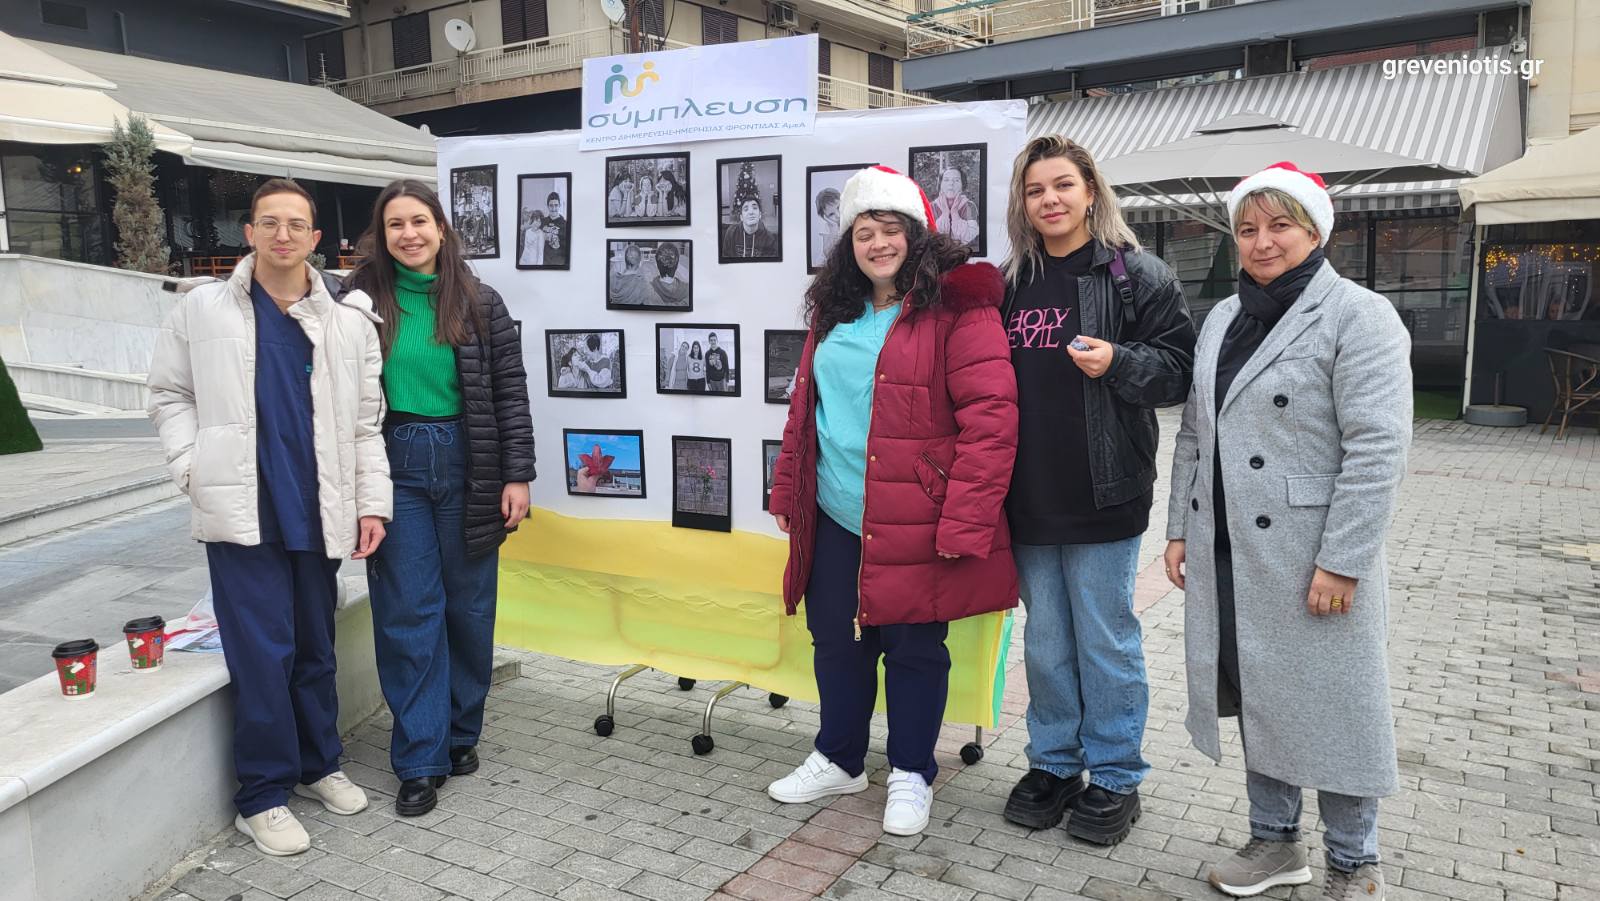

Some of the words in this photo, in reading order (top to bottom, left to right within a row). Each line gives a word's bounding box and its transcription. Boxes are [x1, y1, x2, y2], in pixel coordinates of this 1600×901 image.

[588, 97, 808, 128] σύμπλευση
[585, 135, 617, 144] ΚΕΝΤΡΟ
[727, 122, 780, 131] ΦΡΟΝΤΙΔΑΣ
[1007, 307, 1072, 331] HOLY
[1007, 327, 1060, 349] EVIL
[693, 362, 701, 373] 8
